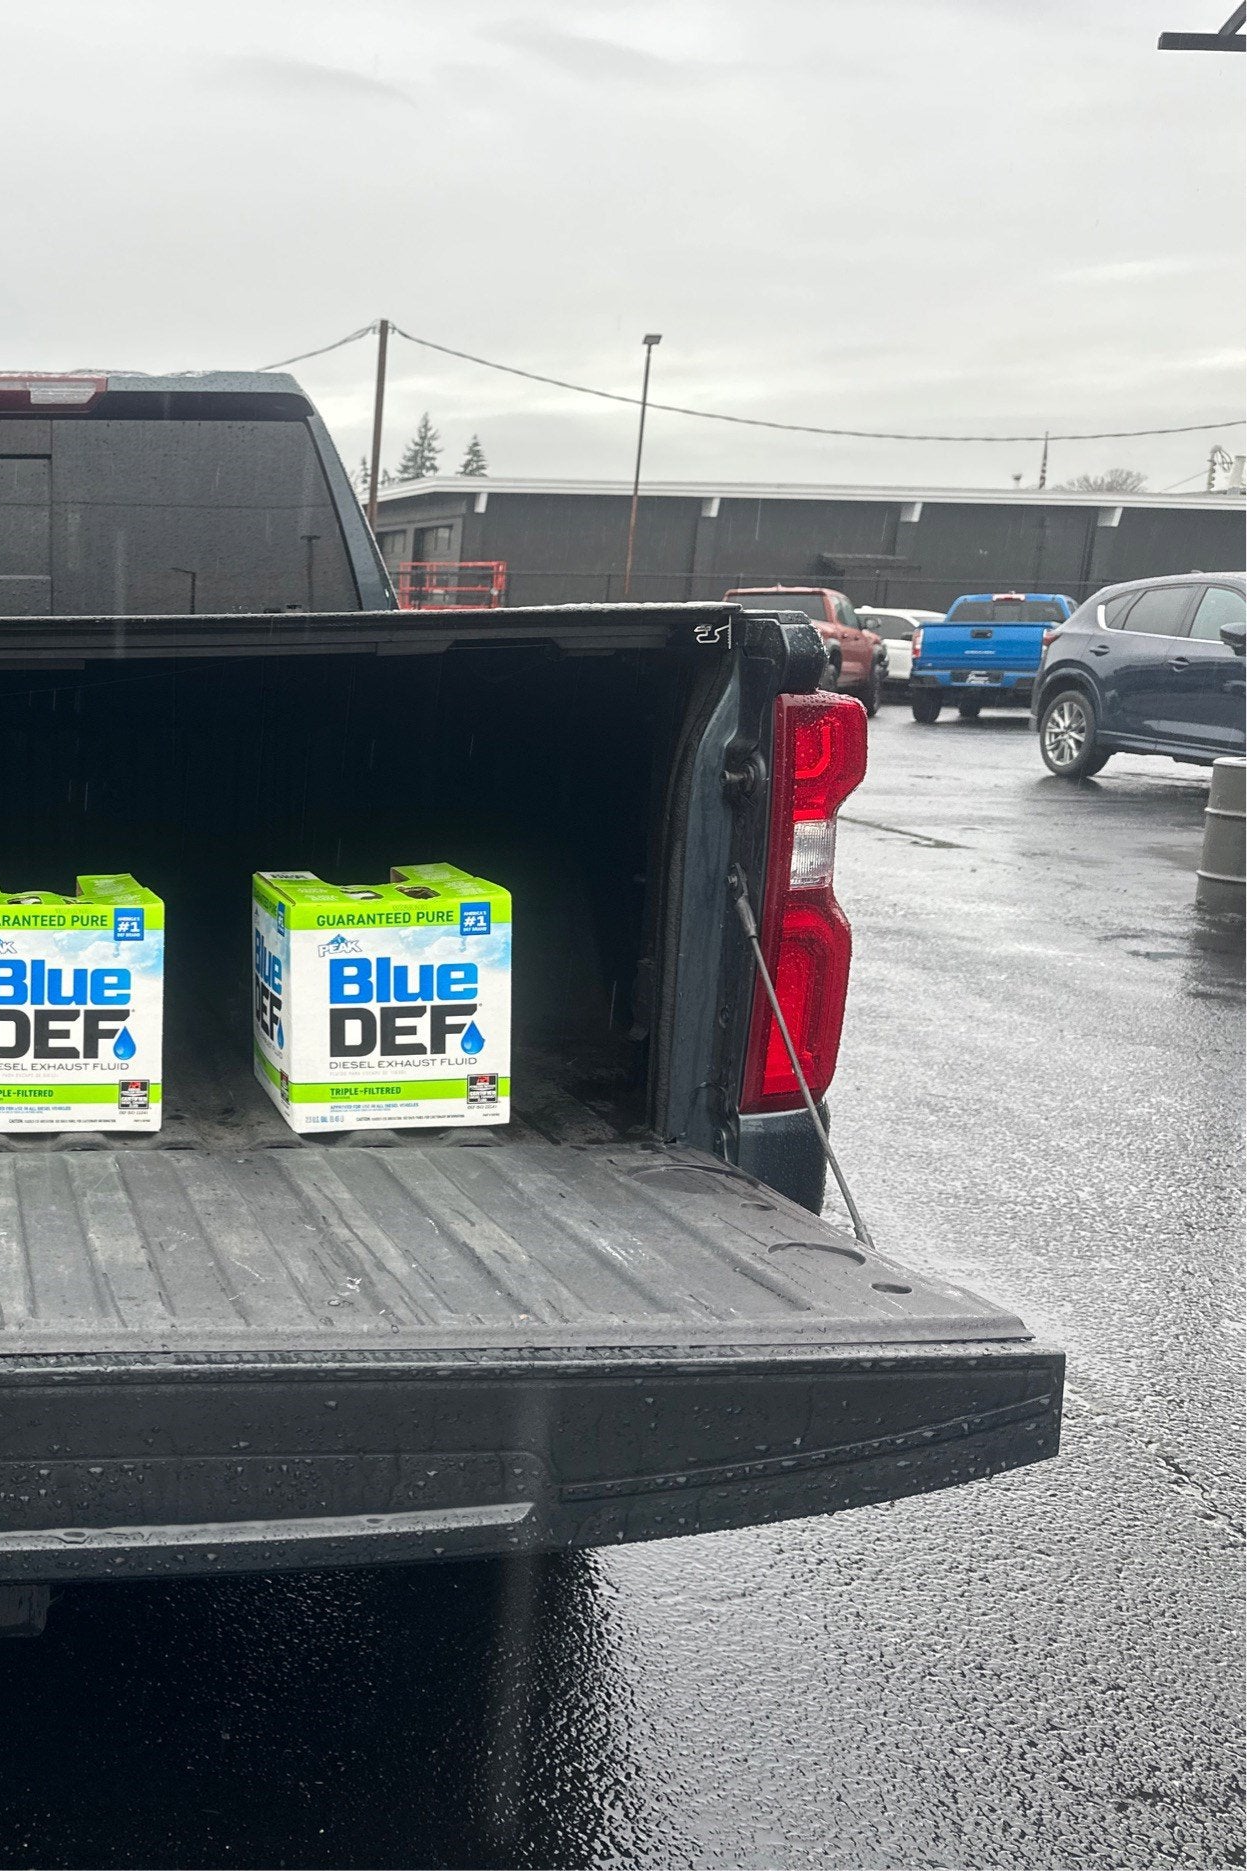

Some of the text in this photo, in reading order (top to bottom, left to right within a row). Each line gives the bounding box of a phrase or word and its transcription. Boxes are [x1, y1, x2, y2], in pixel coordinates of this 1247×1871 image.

[71, 914, 107, 926] PURE
[317, 910, 454, 926] GUARANTEED PURE
[463, 916, 487, 926] #1
[117, 922, 140, 932] #1
[318, 940, 363, 957] PEAK
[255, 928, 282, 996] Blue
[329, 957, 478, 1004] Blue
[254, 973, 282, 1041] DEF
[329, 1004, 478, 1058] DEF
[30, 1063, 89, 1071] EXHAUST
[92, 1062, 129, 1070] FLUID
[329, 1057, 477, 1070] DIESEL EXHAUST FLUID
[330, 1087, 401, 1096] TRIPLE-FILTERED
